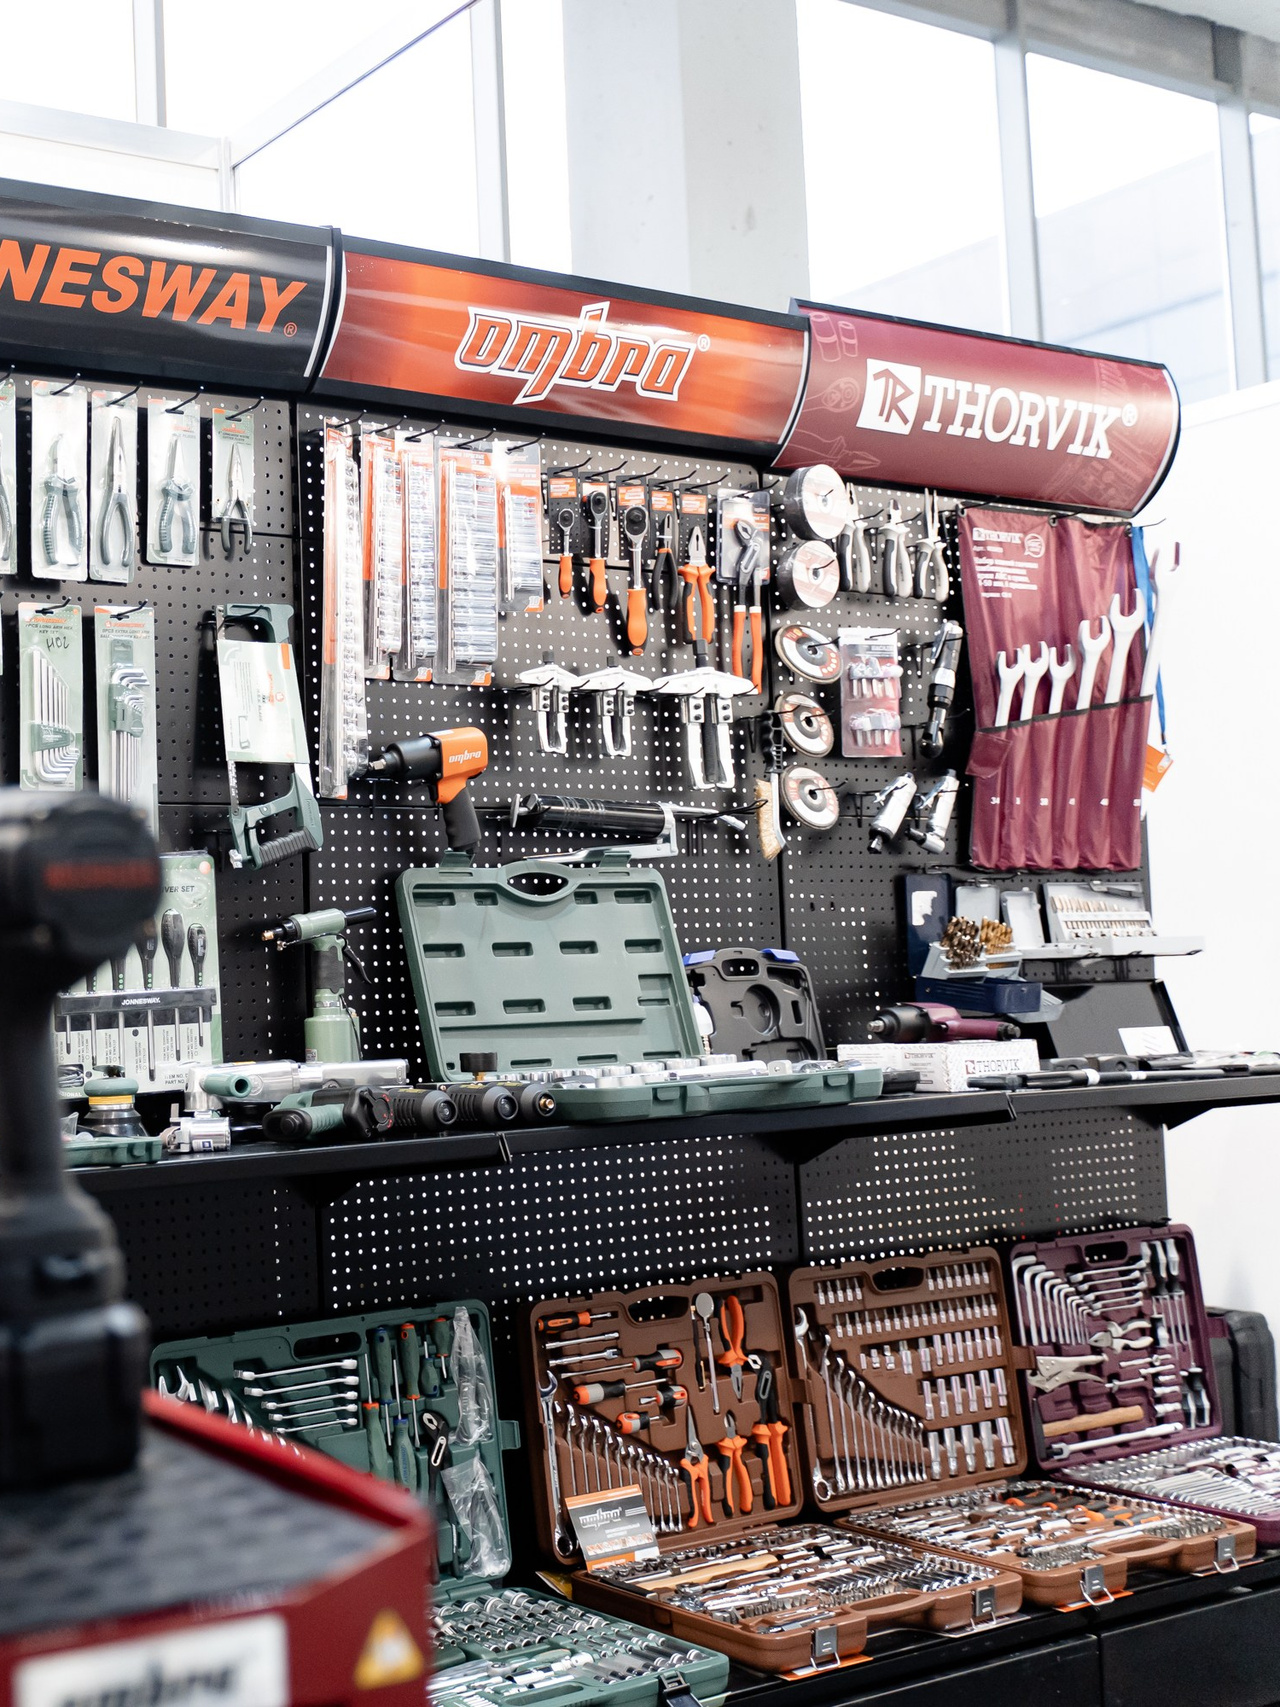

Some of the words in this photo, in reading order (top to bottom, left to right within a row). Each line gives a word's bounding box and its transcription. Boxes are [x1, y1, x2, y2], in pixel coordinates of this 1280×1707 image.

[922, 374, 1123, 460] THORVIK
[448, 750, 482, 764] ombra
[181, 885, 195, 893] SET
[121, 997, 160, 1006] JONNESWAY
[976, 1059, 1021, 1073] THORVIK
